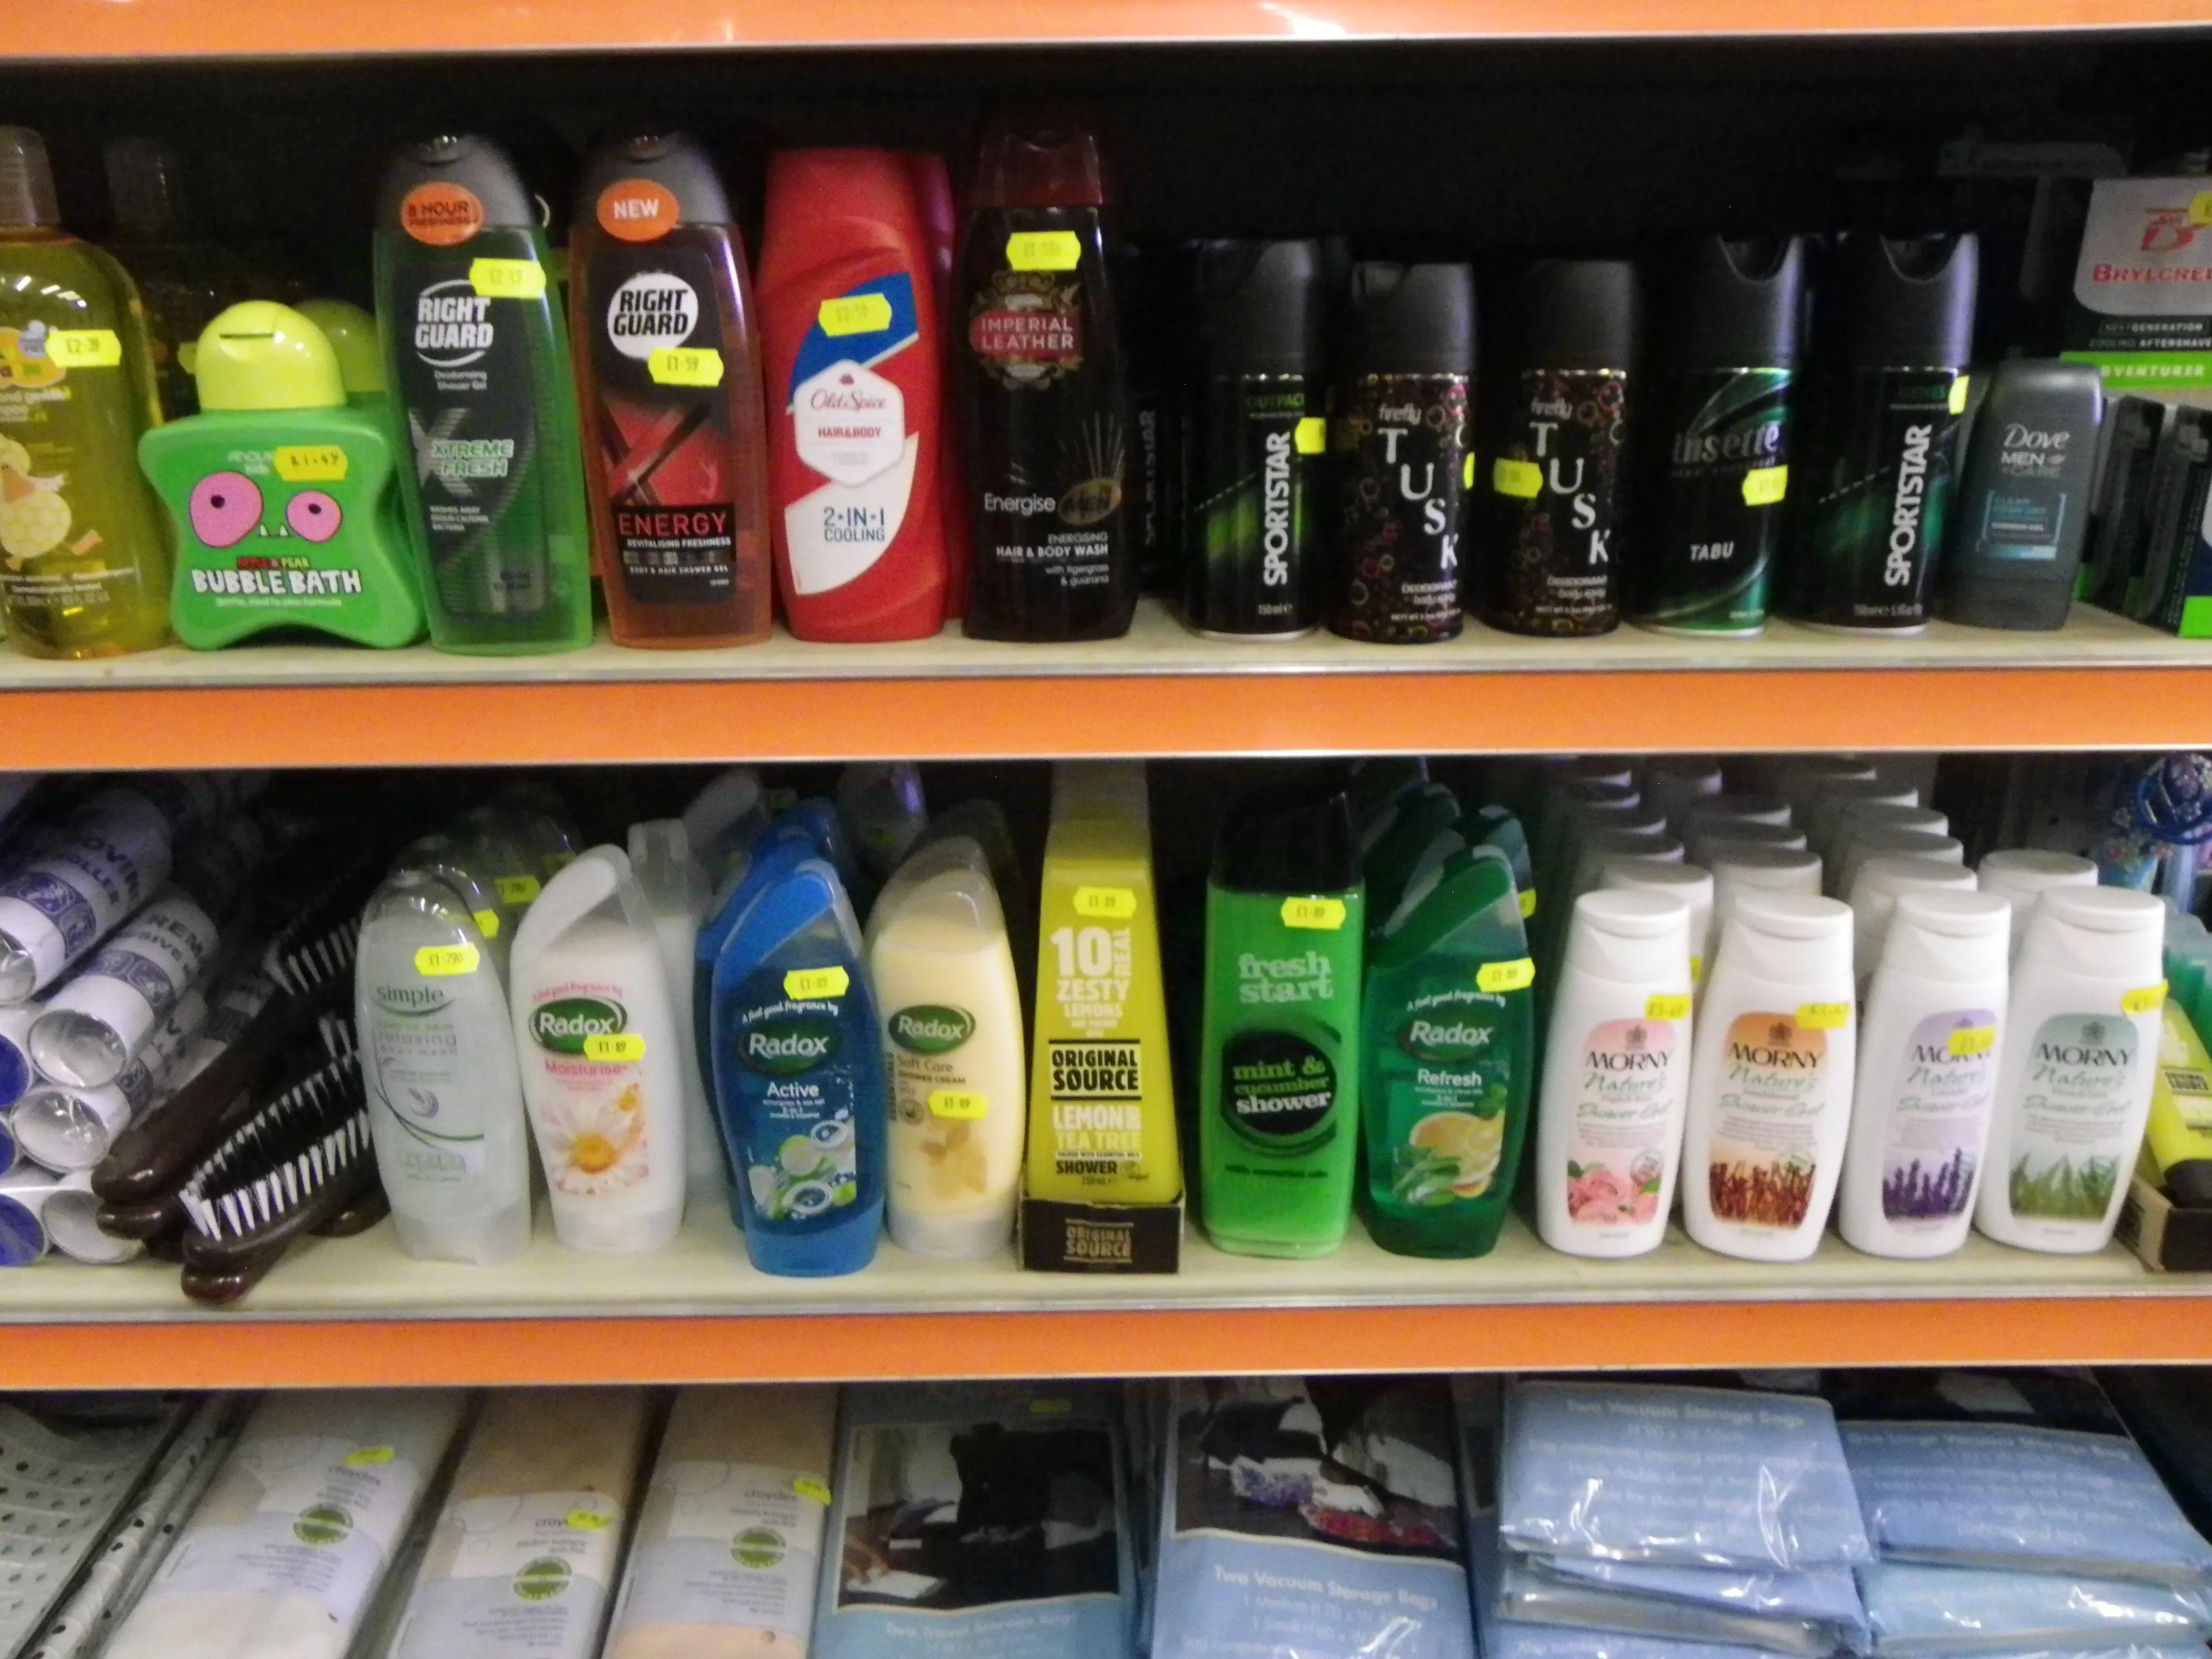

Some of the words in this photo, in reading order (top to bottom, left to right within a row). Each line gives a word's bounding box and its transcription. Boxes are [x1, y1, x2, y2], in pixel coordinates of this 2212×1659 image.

[613, 198, 659, 219] NEW
[418, 297, 491, 322] RIGHT
[620, 289, 688, 313] RIGHT
[415, 324, 494, 348] GUARD
[613, 313, 688, 337] GUARD
[980, 316, 1073, 332] IMPERIAL
[980, 333, 1074, 350] LEATHER
[2003, 423, 2070, 450] Dove
[984, 492, 1056, 517] Energise
[1262, 431, 1291, 587] SPORTSTAR
[1883, 424, 1933, 587] SPORTSTAR
[618, 512, 727, 537] ENERGY
[824, 528, 885, 542] COOLING
[996, 545, 1024, 557] HAIR
[1037, 545, 1071, 558] BODY
[1075, 543, 1109, 557] WASH
[1689, 541, 1735, 562] TABU
[191, 569, 286, 594] BUBBLE
[288, 568, 362, 594] BATH
[1050, 926, 1113, 978] 10
[1238, 950, 1333, 979] fresh
[377, 985, 445, 1008] simple
[1056, 978, 1130, 1002] ZESTY
[1239, 975, 1334, 1004] start
[540, 1011, 616, 1039] Radox
[898, 1014, 966, 1041] Radox
[1410, 1020, 1494, 1048] Radox
[749, 1032, 830, 1060] Radox
[1052, 1049, 1138, 1067] ORIGINAL
[1728, 1042, 1824, 1069] MORNY
[2036, 1043, 2135, 1067] MORNY
[1233, 1059, 1296, 1081] mint
[1302, 1055, 1326, 1076] &
[1585, 1050, 1669, 1071] MORNY
[1053, 1069, 1139, 1091] SOURCE
[1417, 1067, 1482, 1087] Refresh
[766, 1081, 820, 1098] Active
[1235, 1091, 1332, 1115] shower
[1052, 1104, 1125, 1131] LEMON
[1055, 1131, 1090, 1150] TEA
[1096, 1131, 1141, 1150] TREE
[1056, 1160, 1118, 1175] SHOWER
[1066, 1226, 1131, 1243] ORIGINAL
[1065, 1240, 1132, 1258] SOURCE
[1214, 1566, 1250, 1587] Two
[1253, 1571, 1323, 1593] Vacuum
[1327, 1579, 1393, 1606] Storage
[1398, 1589, 1438, 1612] Bags
